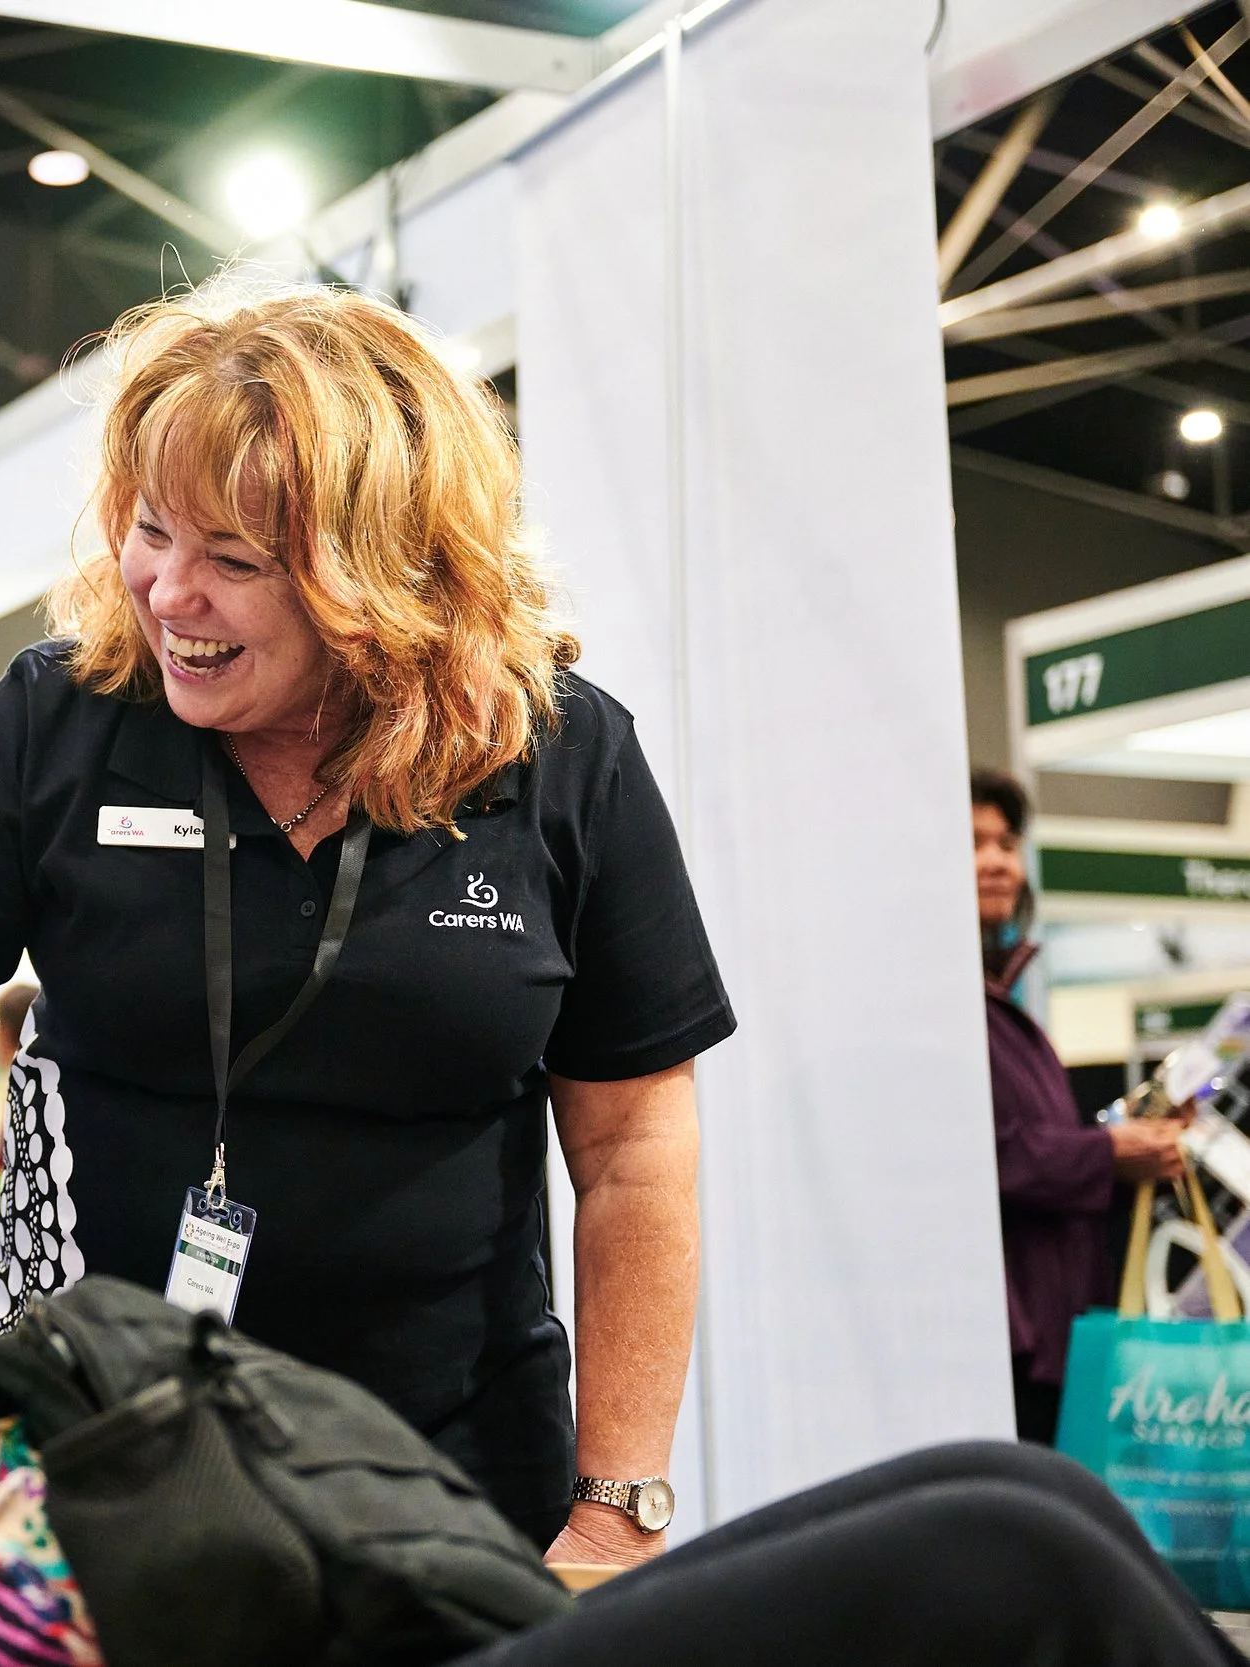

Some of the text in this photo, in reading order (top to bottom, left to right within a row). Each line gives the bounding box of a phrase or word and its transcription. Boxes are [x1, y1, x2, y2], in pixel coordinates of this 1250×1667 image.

[1043, 652, 1104, 713] 177
[107, 828, 131, 836] arers
[428, 910, 525, 932] Carers WA
[195, 1226, 216, 1241] Ageing
[216, 1233, 227, 1244] Well
[226, 1238, 241, 1250] Expo
[187, 1278, 214, 1295] Carers WA
